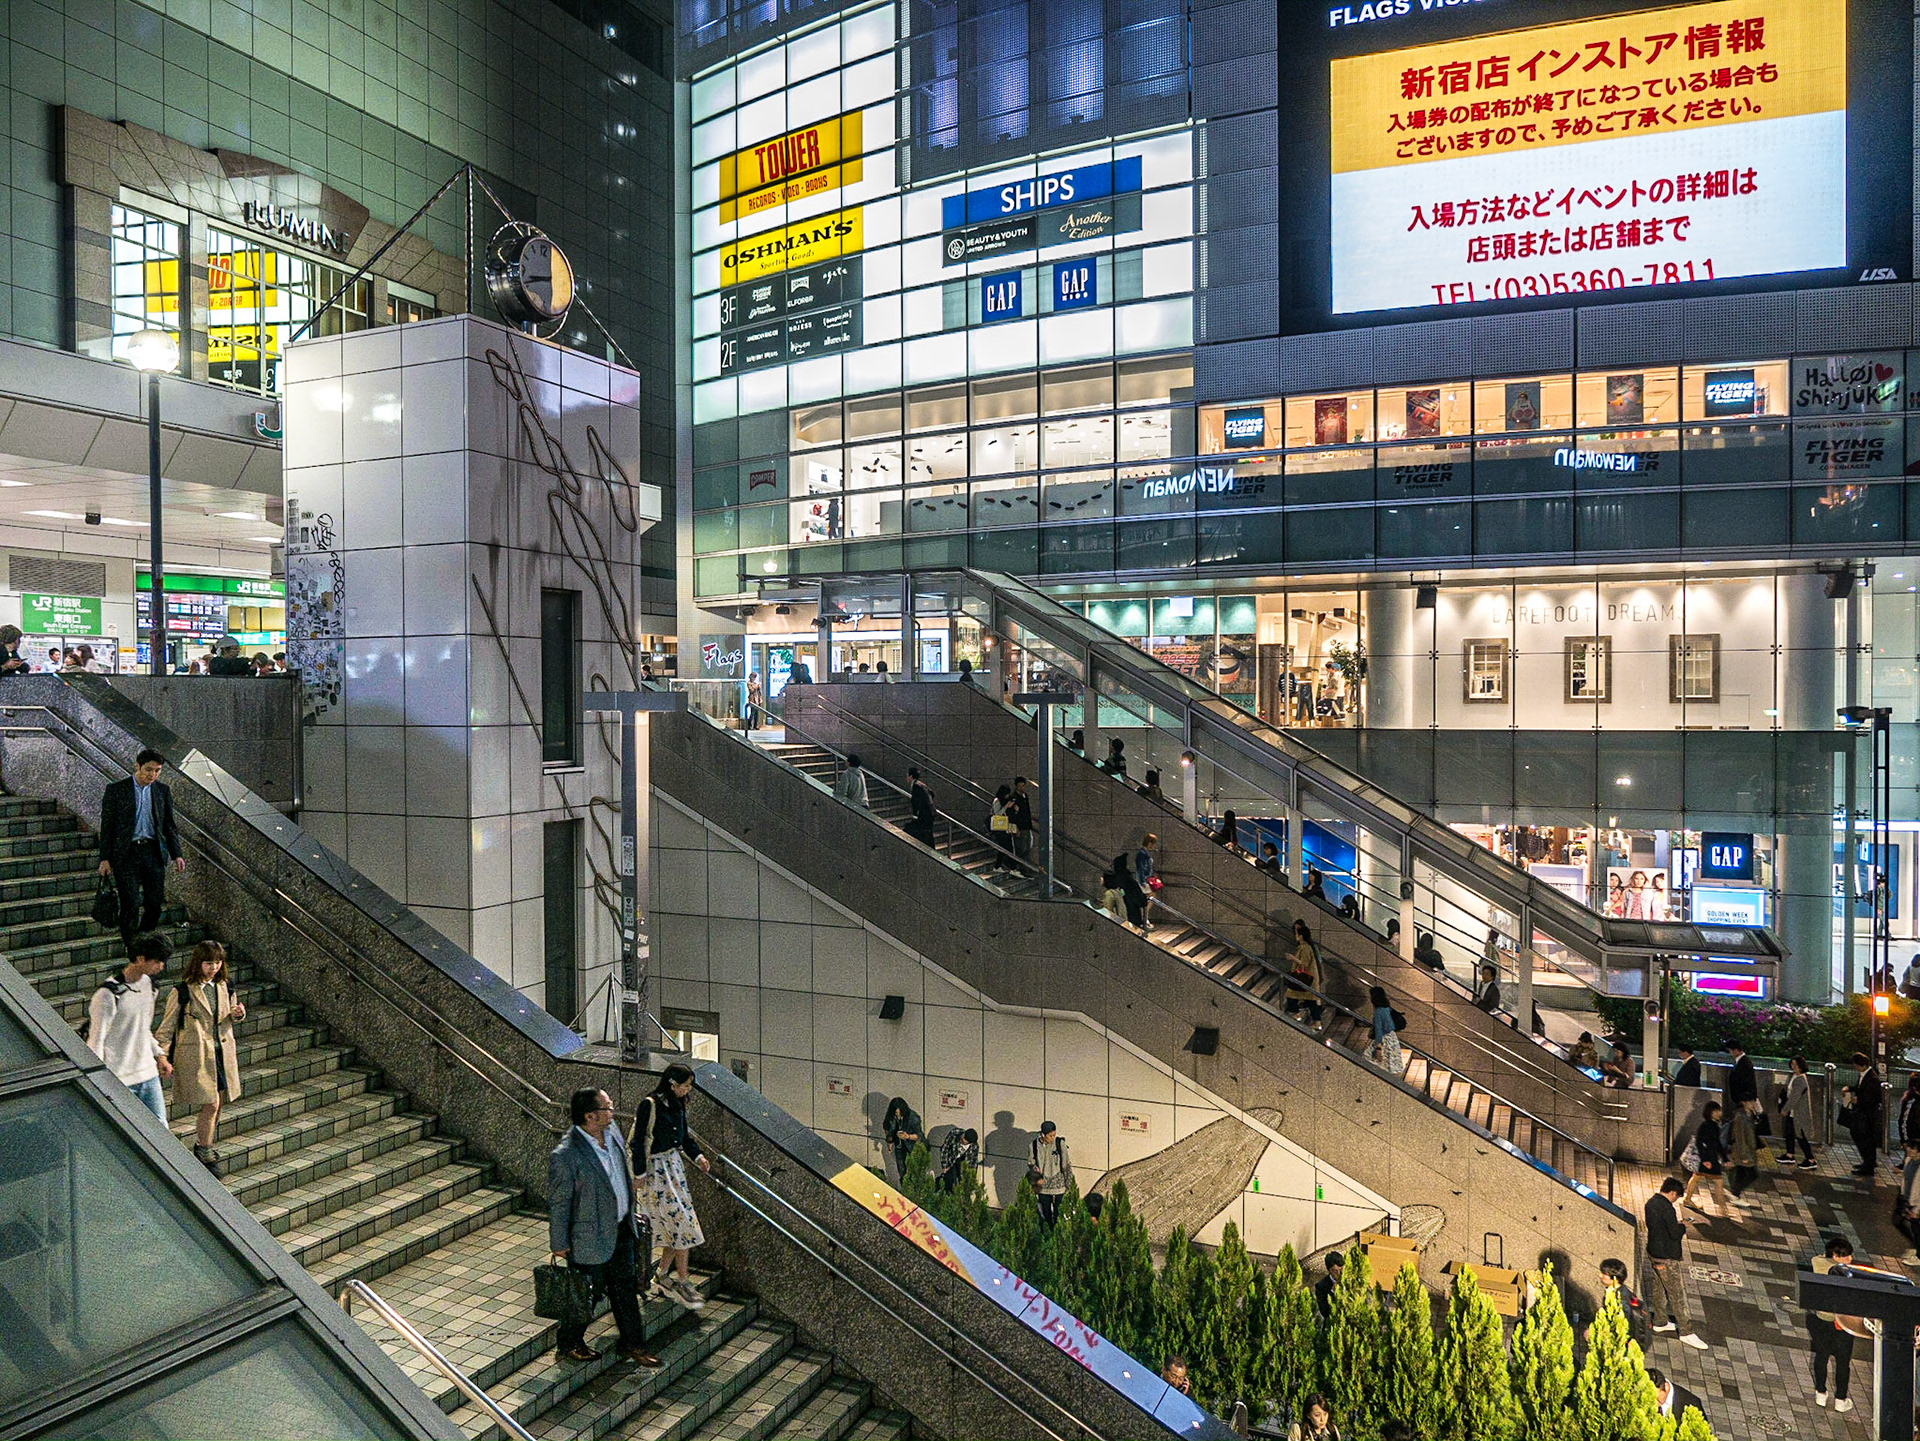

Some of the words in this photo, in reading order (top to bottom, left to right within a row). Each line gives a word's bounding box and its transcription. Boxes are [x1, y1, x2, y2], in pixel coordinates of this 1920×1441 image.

[1329, 0, 1411, 27] FLAGS
[1401, 17, 1766, 100] 新宿店インストア情報
[1387, 62, 1779, 133] 入場券の配布が終了になっている場合も
[1396, 97, 1762, 159] ございますので、予めご了承ください。
[755, 129, 820, 184] TOWER
[748, 192, 777, 211] RECORDS
[805, 175, 828, 193] BOOKS
[1001, 174, 1074, 213] SHIPS
[1407, 167, 1758, 232] 入場方法などイベントの詳細は
[254, 200, 350, 252] LUMINE
[1060, 211, 1112, 232] Another
[1069, 225, 1104, 239] Edition
[723, 219, 853, 268] OSHMAN'S
[1467, 215, 1691, 264] 店頭または店舗まで
[791, 249, 815, 262] Goods
[1061, 267, 1088, 295] GAP
[1859, 267, 1898, 282] LISA
[986, 281, 1017, 313] GAP
[721, 295, 736, 324] 3F
[722, 340, 737, 368] 2F
[1705, 389, 1754, 399] TIGER
[1706, 382, 1754, 392] FLYING
[1225, 418, 1264, 428] FLYING
[1225, 425, 1264, 435] TIGER
[1806, 438, 1885, 451] FLYING
[1805, 450, 1885, 464] TIGER
[751, 471, 775, 487] CAMPER
[1394, 472, 1453, 484] TIGER
[1395, 463, 1453, 474] FLYING
[237, 581, 251, 590] JR
[32, 597, 52, 608] JR
[1493, 605, 1592, 624] BAREFOOT
[702, 643, 743, 675] Flags
[1711, 846, 1742, 867] GAP
